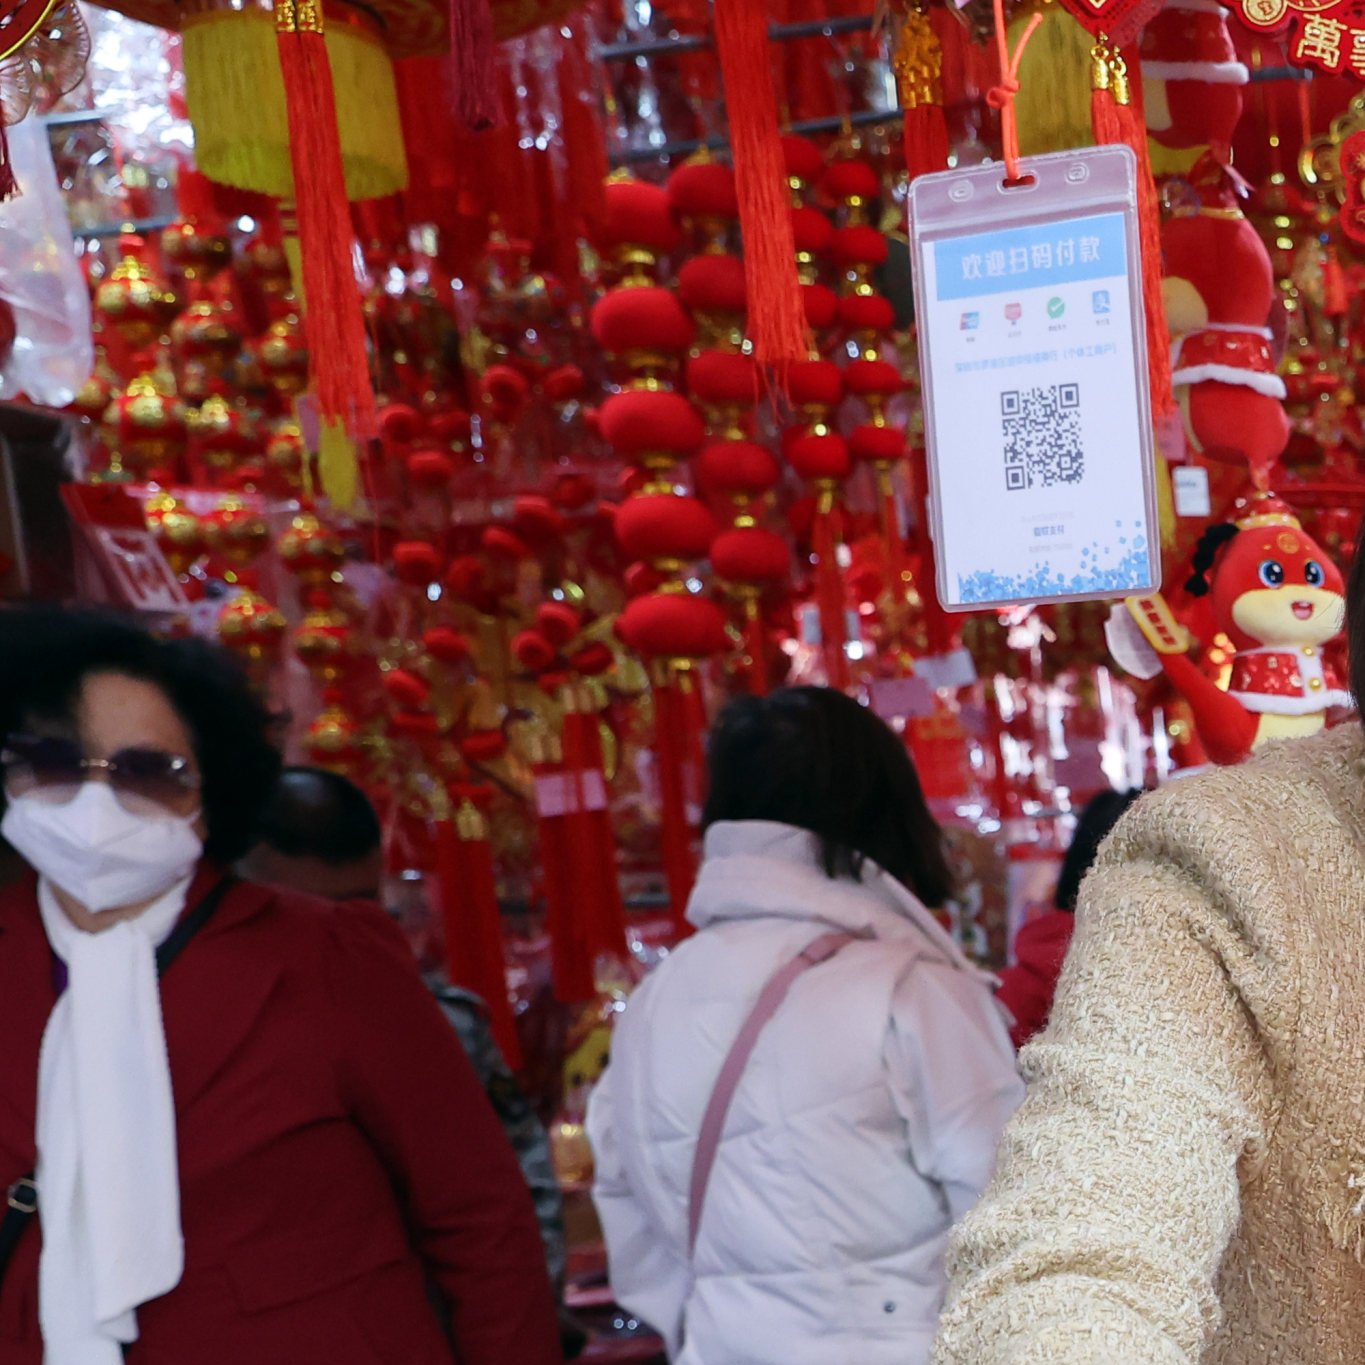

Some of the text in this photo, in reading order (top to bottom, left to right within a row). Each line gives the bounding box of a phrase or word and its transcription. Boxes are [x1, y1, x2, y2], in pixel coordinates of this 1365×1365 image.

[961, 236, 1101, 280] 欢迎扫码付款
